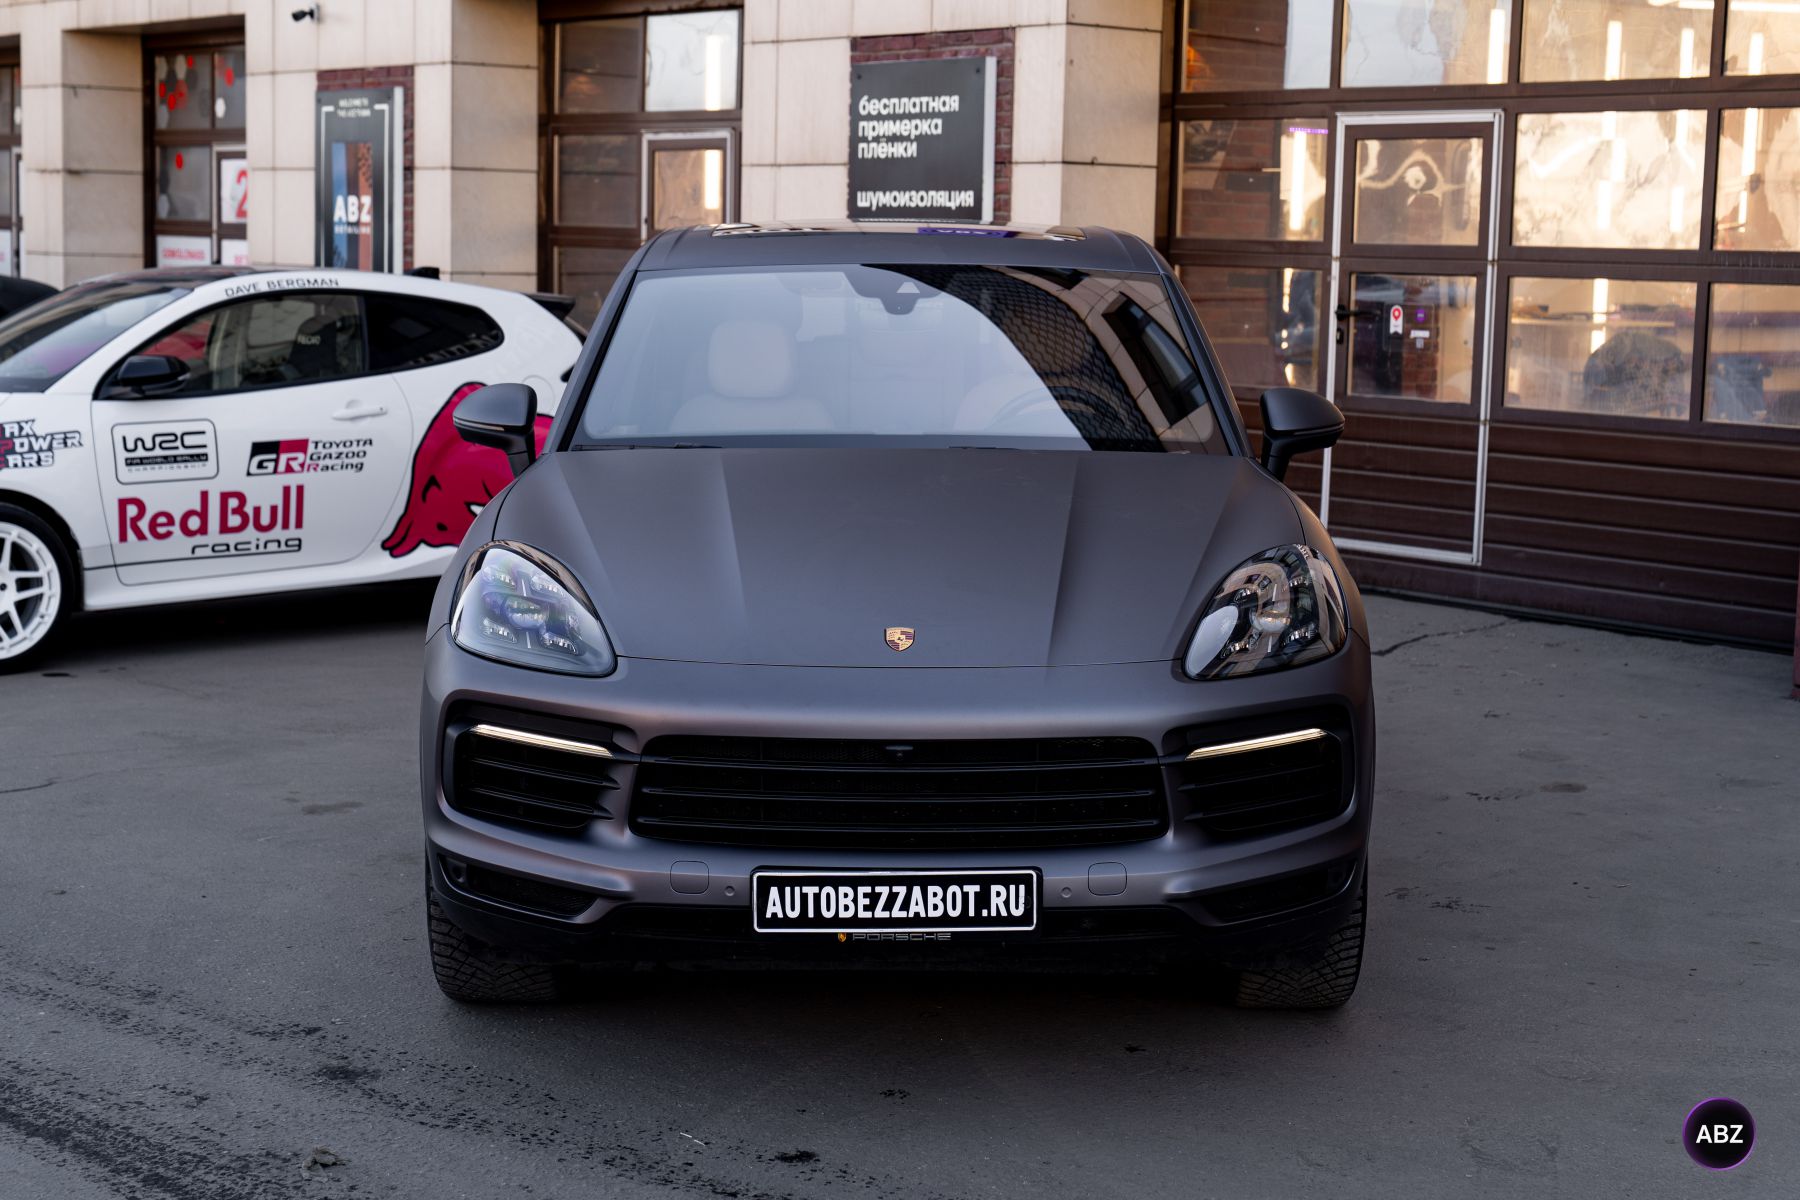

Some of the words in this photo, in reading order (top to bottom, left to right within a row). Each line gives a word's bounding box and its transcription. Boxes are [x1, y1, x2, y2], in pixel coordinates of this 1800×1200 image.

[859, 95, 959, 116] бесплатная
[858, 118, 943, 141] примерка
[858, 138, 917, 159] плёнки
[333, 195, 372, 223] ABZ
[857, 190, 975, 211] шумоизоляция
[225, 283, 261, 297] DAVE
[266, 278, 340, 290] BERGMAN
[0, 421, 35, 438] AX
[122, 431, 207, 453] WRC
[312, 438, 373, 450] TOYOTA
[249, 451, 306, 475] GR
[309, 450, 367, 461] GAZOO
[307, 461, 364, 473] Racing
[118, 490, 209, 544] Red
[219, 484, 304, 535] Bull
[191, 537, 302, 555] racing
[765, 884, 1025, 918] AUTOBEZZABOT.RU
[852, 932, 951, 941] PORSCHE
